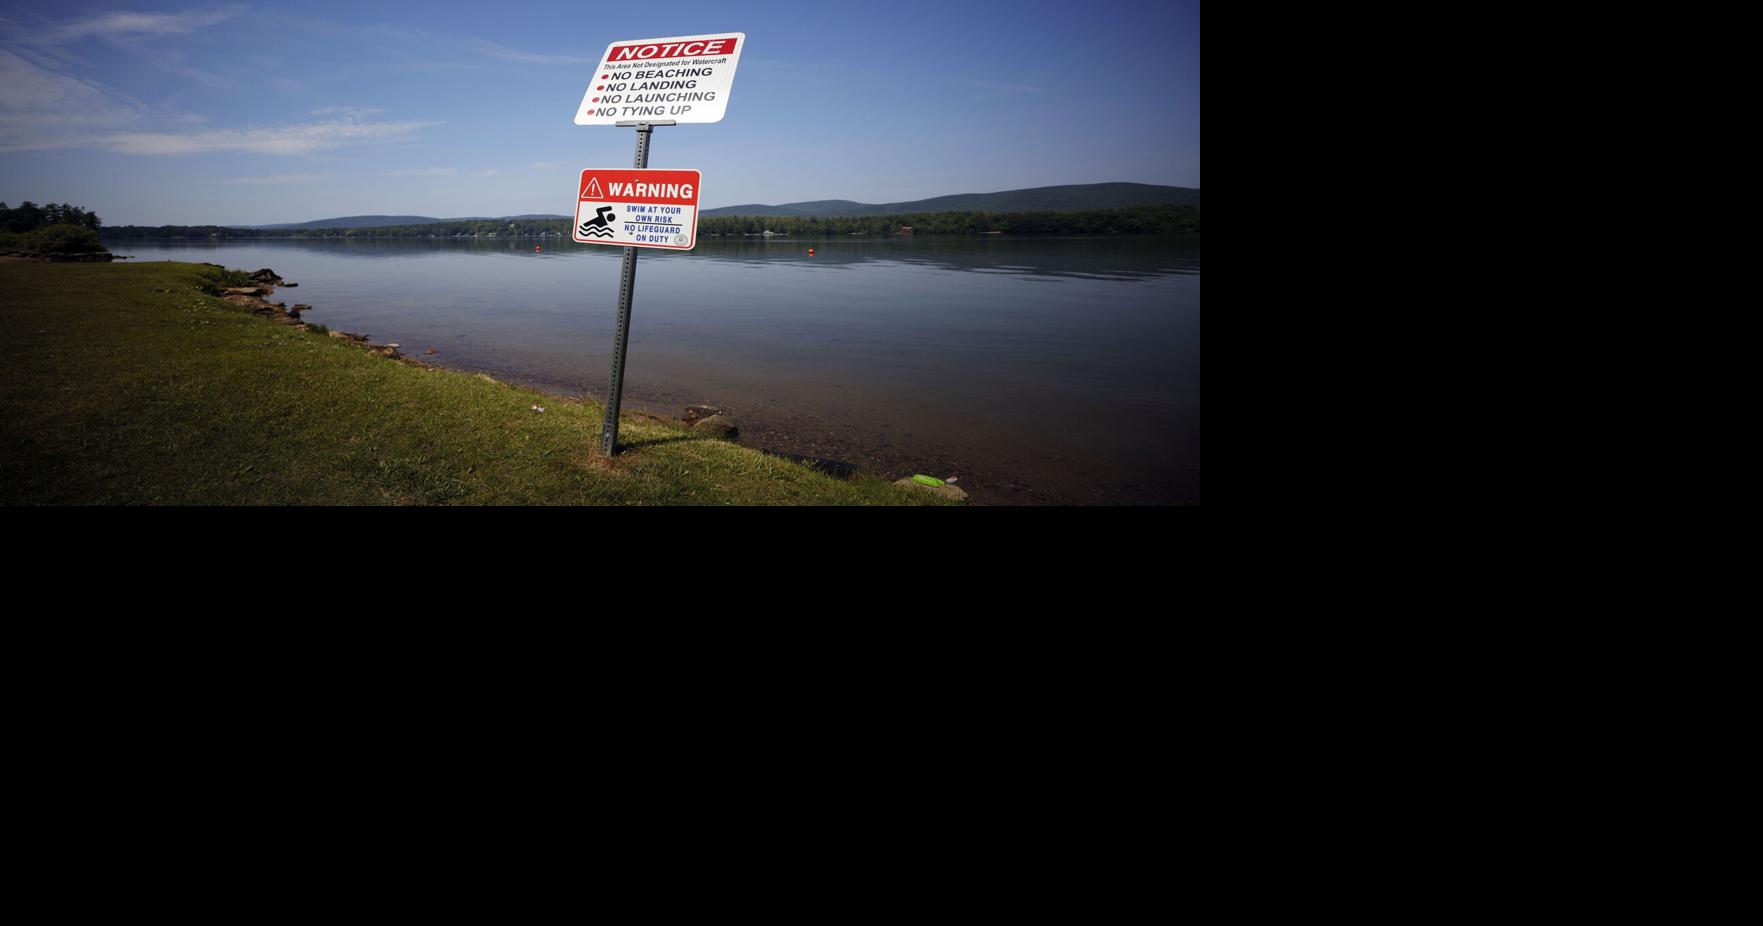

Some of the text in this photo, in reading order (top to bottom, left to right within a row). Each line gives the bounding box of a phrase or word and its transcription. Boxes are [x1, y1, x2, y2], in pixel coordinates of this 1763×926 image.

[616, 40, 726, 60] NOTICE
[645, 60, 679, 68] Designated
[611, 68, 713, 80] NO BEACHING
[606, 80, 697, 91] NO LANDING
[601, 92, 716, 104] NO LAUNCHING
[595, 105, 691, 116] NO TYING UP
[609, 182, 693, 199] WARNING
[626, 205, 681, 215] SWIM AT YOUR
[636, 215, 673, 224] OWN RISK
[638, 225, 680, 234] LIFEGUARD
[649, 235, 669, 243] DUTY
